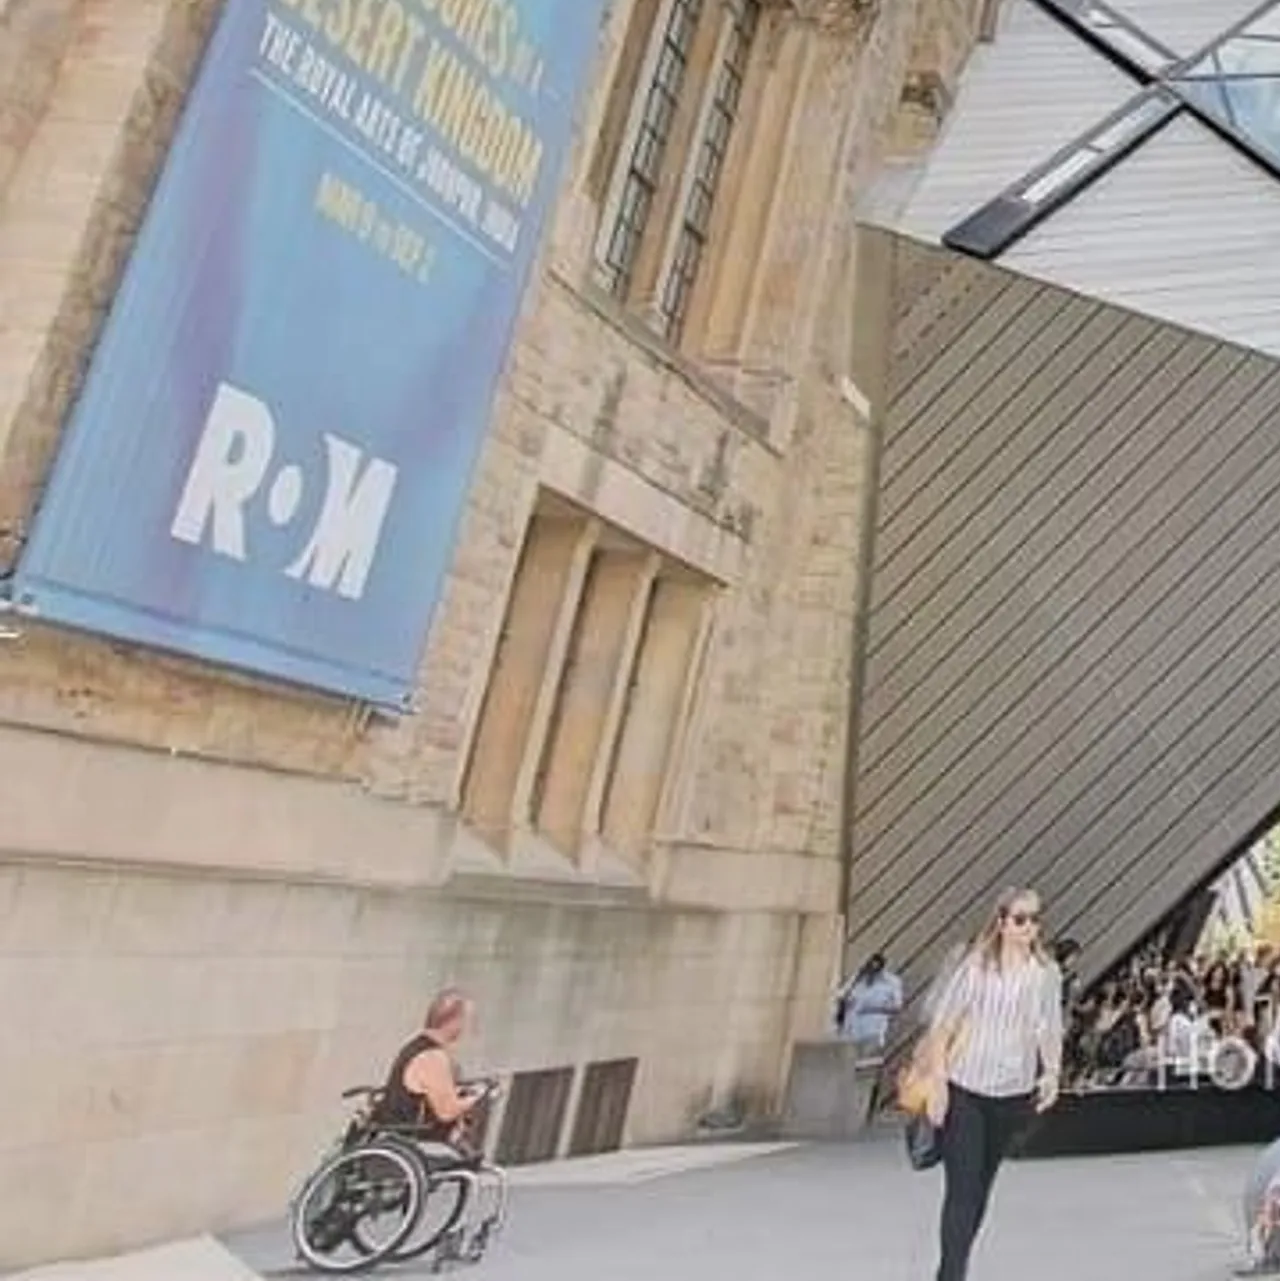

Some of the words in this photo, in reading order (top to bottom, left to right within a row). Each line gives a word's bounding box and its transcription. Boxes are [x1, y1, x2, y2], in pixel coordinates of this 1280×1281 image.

[259, 13, 300, 74] THE
[293, 43, 357, 119] ROYAL
[413, 38, 543, 209] KINGDOM
